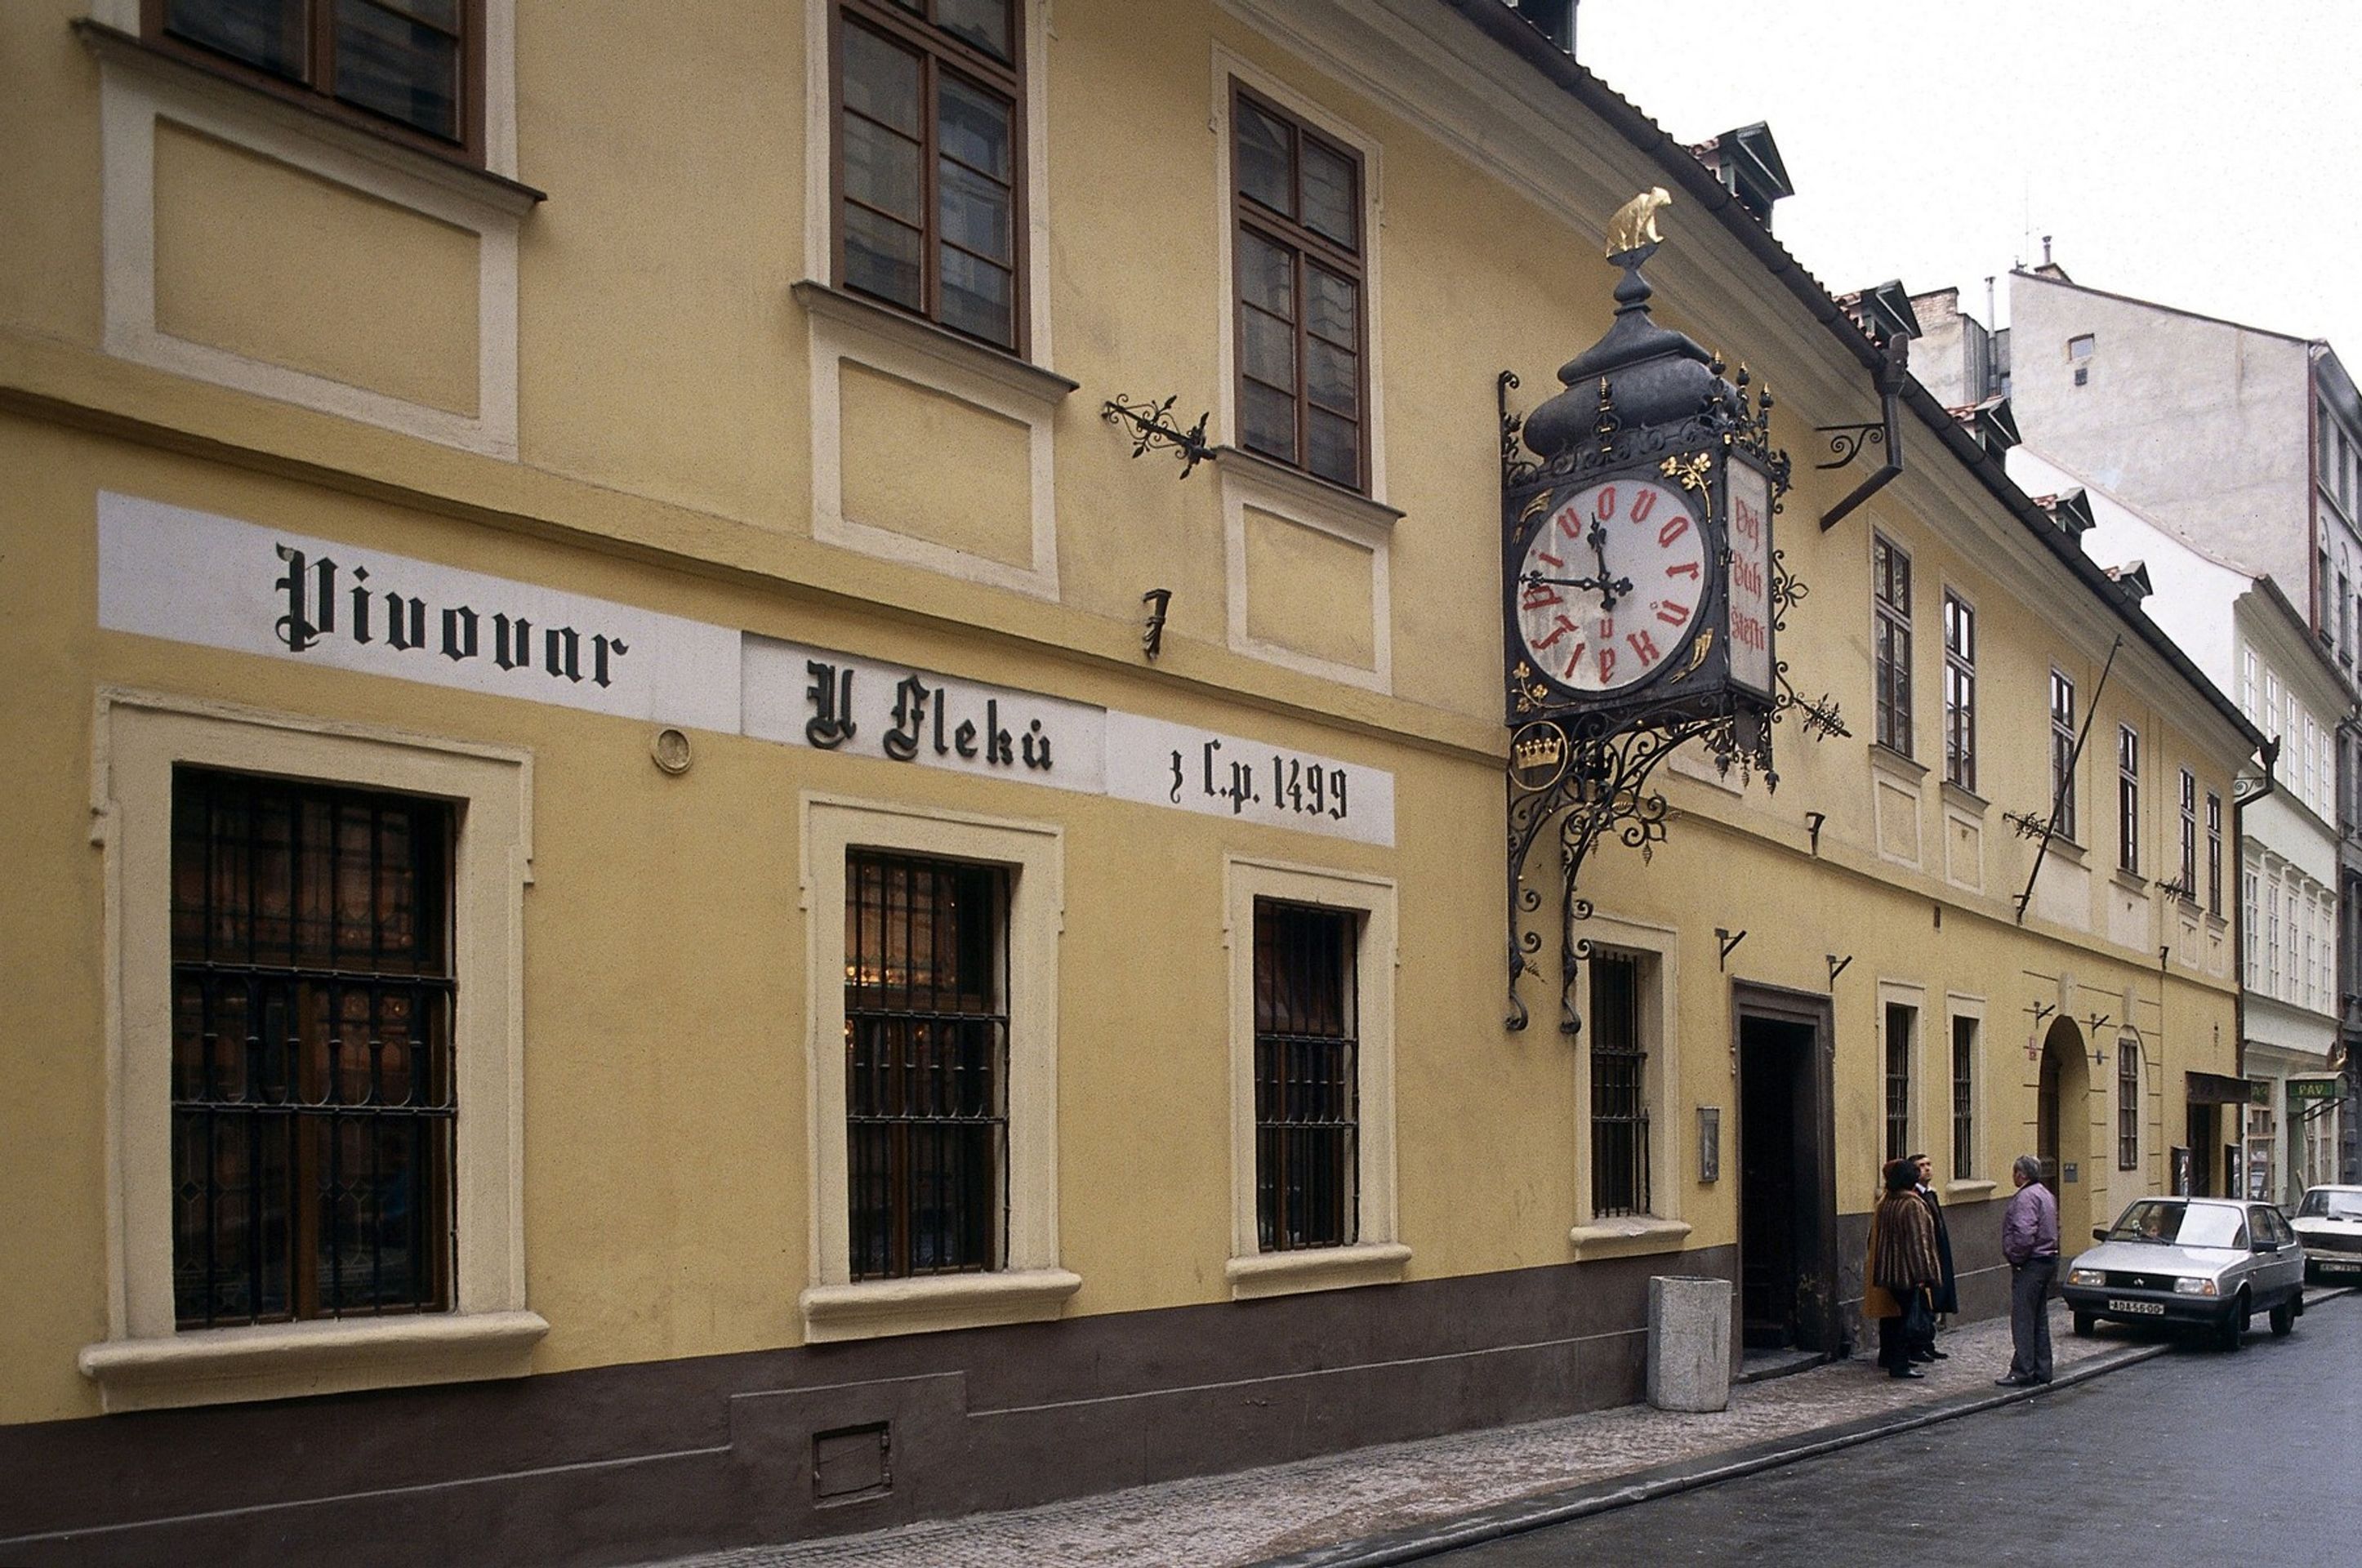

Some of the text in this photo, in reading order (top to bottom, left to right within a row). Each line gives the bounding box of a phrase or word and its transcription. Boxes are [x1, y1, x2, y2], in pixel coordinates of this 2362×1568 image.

[274, 542, 629, 688] Pivovar
[806, 660, 1053, 771] U Fleků
[1170, 750, 1183, 804] z
[1272, 755, 1348, 821] 1499
